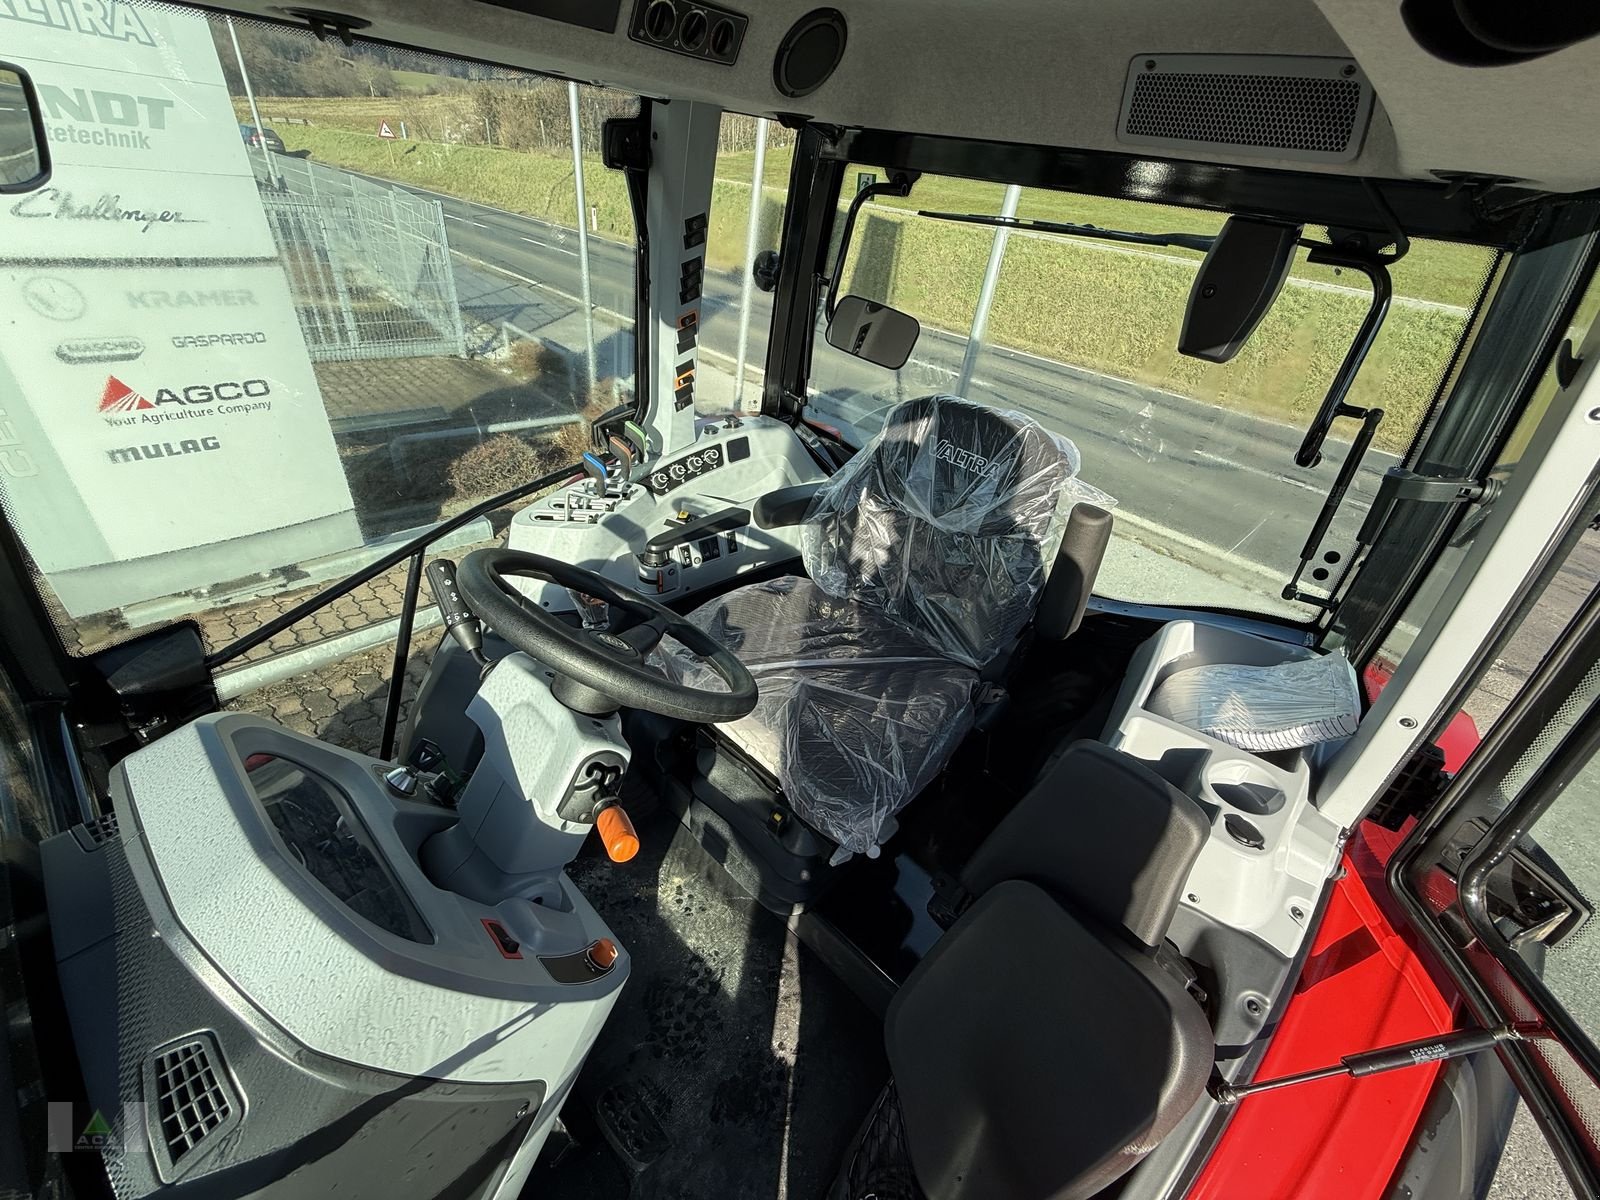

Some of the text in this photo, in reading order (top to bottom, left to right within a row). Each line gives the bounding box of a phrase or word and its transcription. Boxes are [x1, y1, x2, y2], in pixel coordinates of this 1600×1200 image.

[37, 83, 175, 130] NDT
[10, 187, 208, 233] Challenger
[125, 289, 259, 309] KRAMER
[172, 332, 267, 348] GASPARDO
[154, 379, 271, 406] AGCO
[104, 400, 271, 427] Your Agriculture Company
[929, 434, 1000, 481] VALTRA
